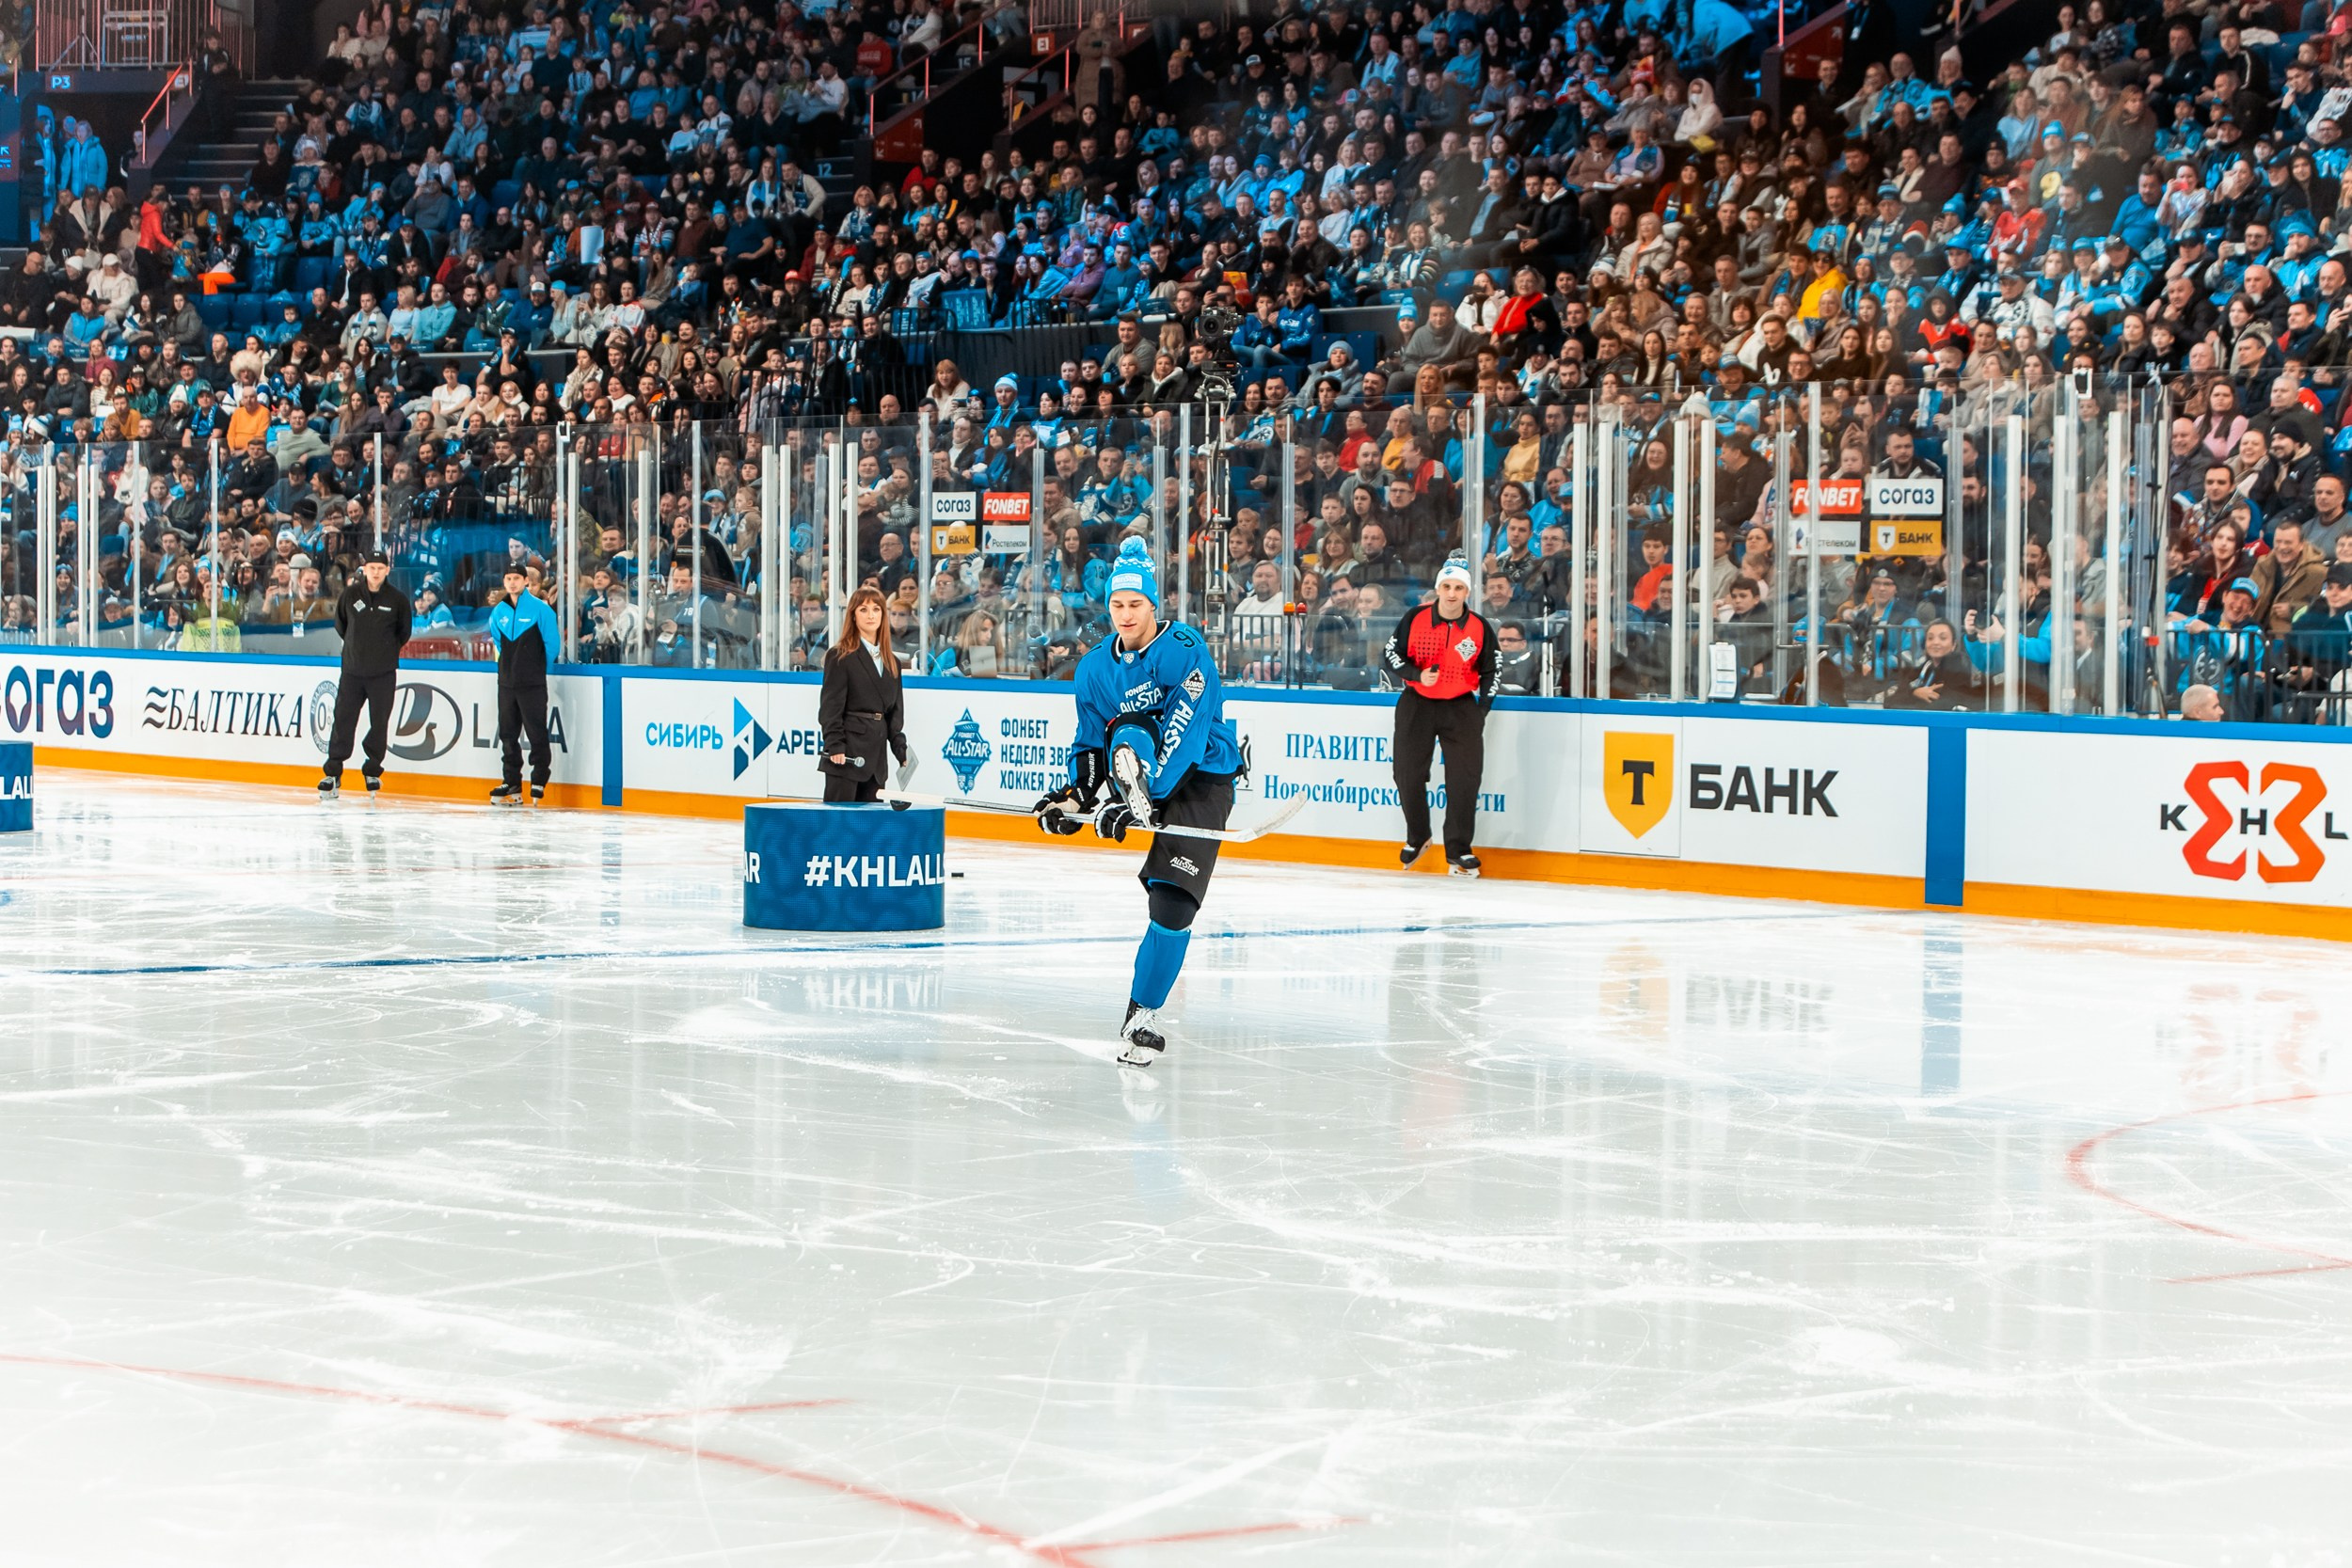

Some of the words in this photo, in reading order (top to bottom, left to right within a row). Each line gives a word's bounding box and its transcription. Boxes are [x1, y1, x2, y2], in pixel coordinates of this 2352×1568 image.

[817, 163, 834, 178] 12
[936, 499, 971, 513] согаз
[983, 498, 1029, 515] FONBET
[1879, 488, 1935, 505] согаз
[948, 534, 971, 545] БАНК
[992, 539, 1027, 548] Ростелеком
[1805, 536, 1857, 548] Рстелеком
[1899, 531, 1934, 544] БАНК
[1124, 680, 1152, 699] FONBET
[0, 665, 114, 739] огаз
[166, 688, 303, 738] БАЛТИКА
[645, 721, 723, 751] СИБИРЬ
[1001, 717, 1049, 739] ФОНБЕТ
[1000, 744, 1045, 768] НЕДЕЛЯ
[1049, 746, 1071, 767] ЗВЕ
[999, 769, 1044, 792] ХОККЕЯ
[1690, 763, 1839, 817] БАНК
[1263, 774, 1402, 812] Новосибирско
[804, 843, 945, 887] #KHLALL
